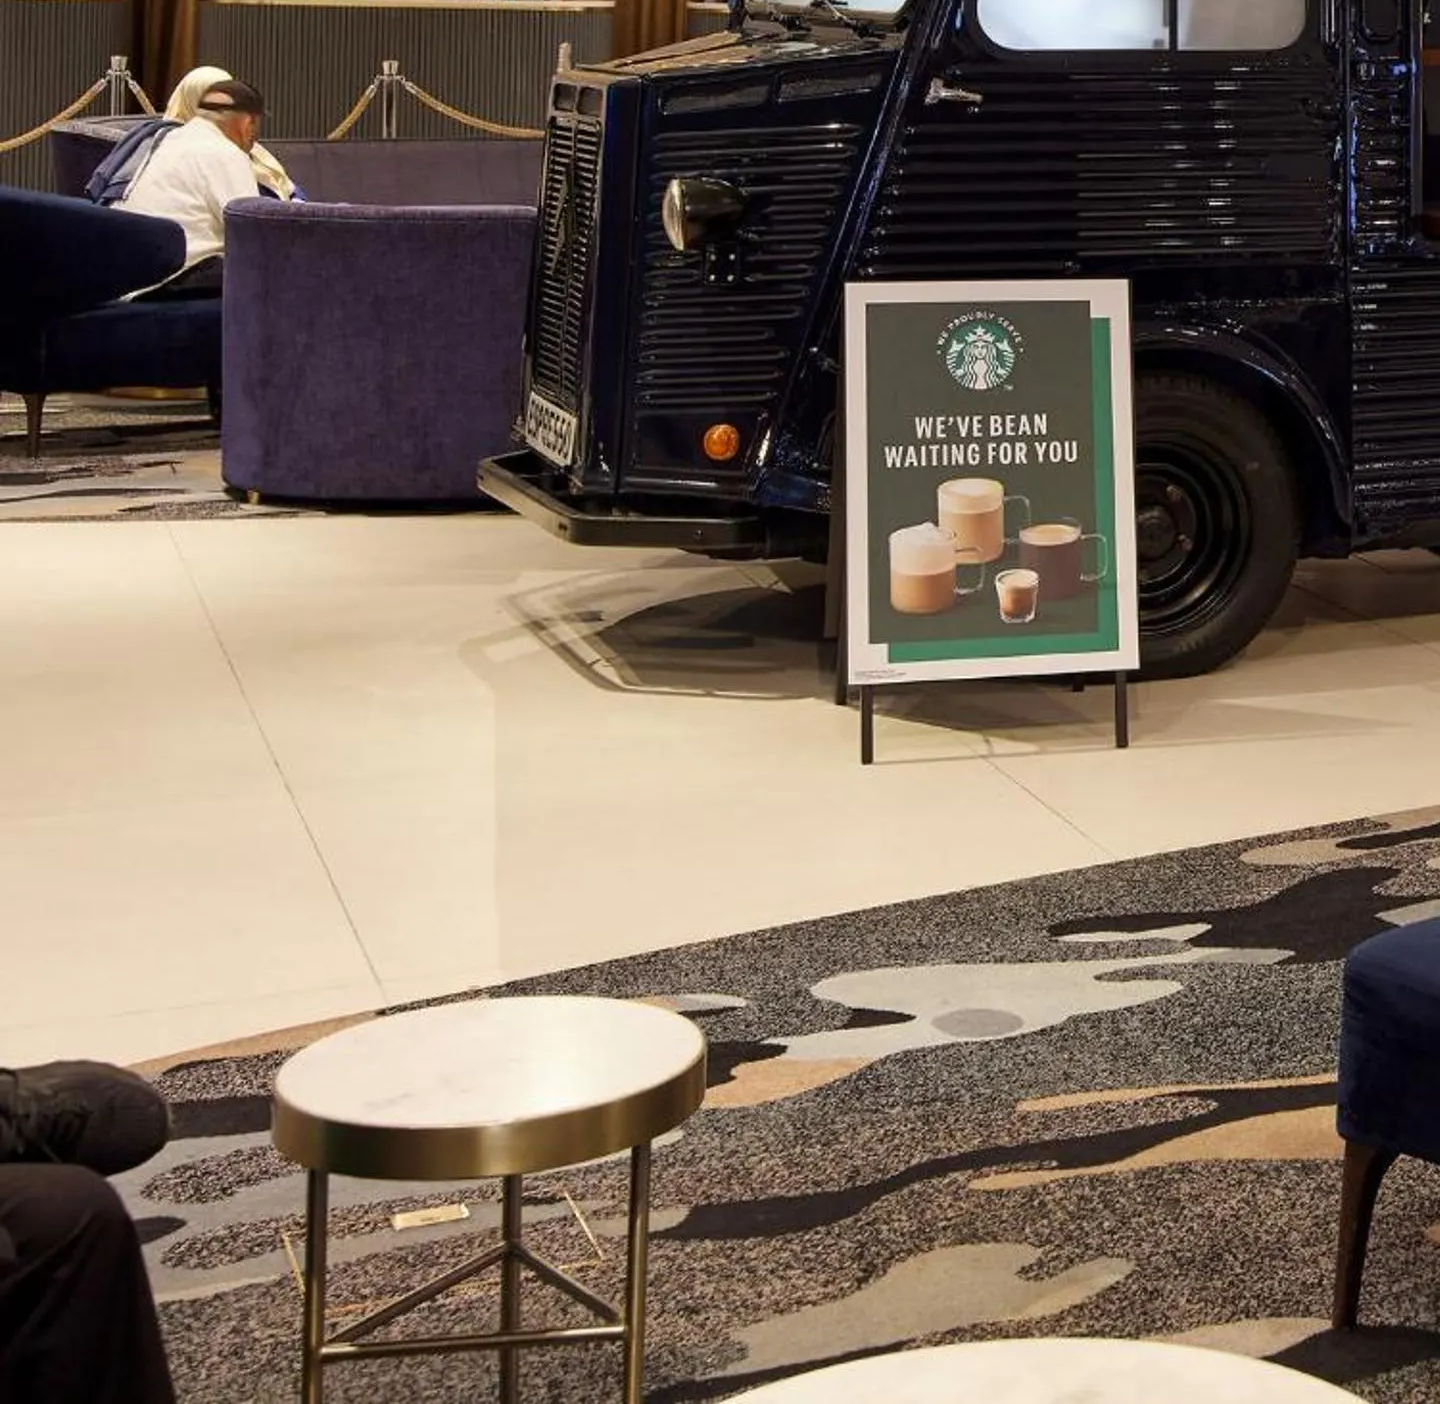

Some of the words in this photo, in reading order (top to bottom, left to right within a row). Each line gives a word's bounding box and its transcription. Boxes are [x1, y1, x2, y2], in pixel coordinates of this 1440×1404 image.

[989, 413, 1048, 437] BEAN
[884, 443, 981, 469] WAITING
[987, 442, 1028, 465] FOR
[1034, 440, 1078, 463] YOU
